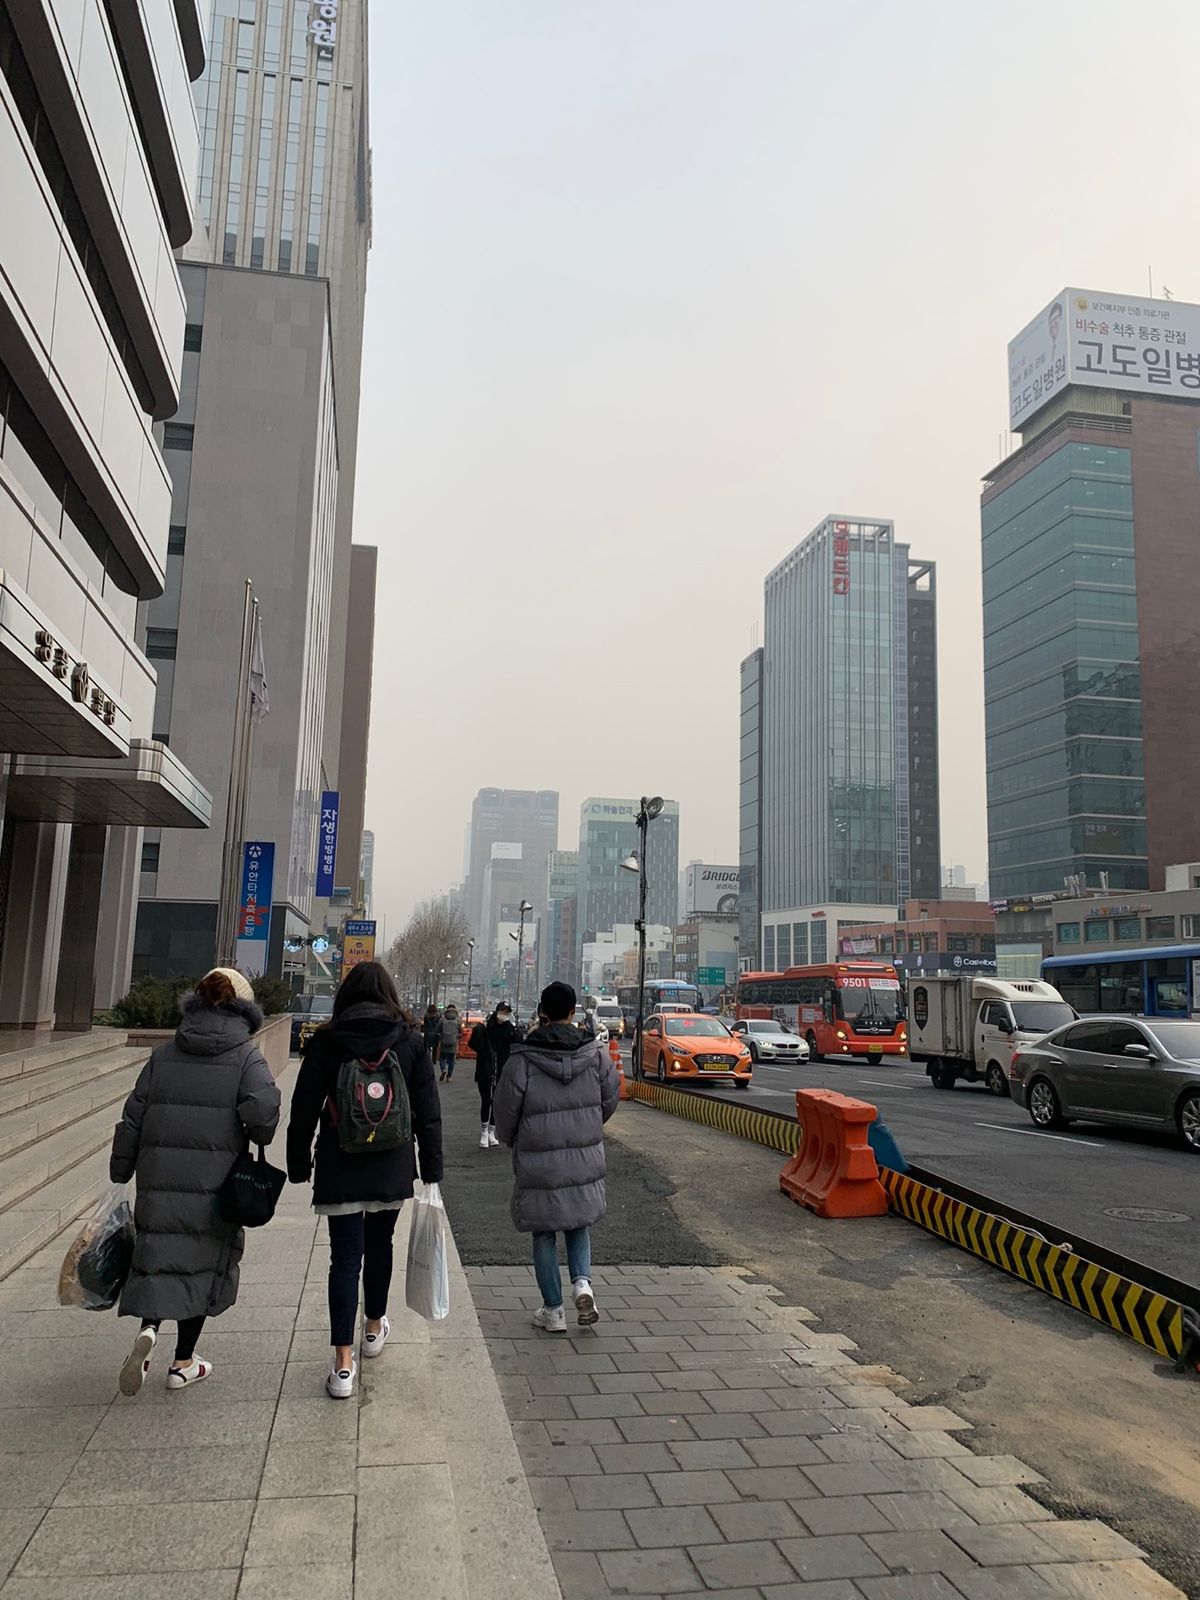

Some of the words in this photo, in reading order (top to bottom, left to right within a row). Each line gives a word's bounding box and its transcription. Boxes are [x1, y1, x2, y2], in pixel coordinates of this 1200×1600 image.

[1075, 319, 1109, 335] 비수술
[1112, 322, 1135, 338] 척추
[1138, 326, 1161, 342] 통증
[1163, 329, 1186, 345] 관절
[1012, 355, 1066, 418] 고도일병원
[321, 809, 337, 875] 자생한방병원
[244, 861, 260, 937] 유안타저축은행
[349, 948, 369, 956] Alpha
[842, 977, 867, 988] 9501
